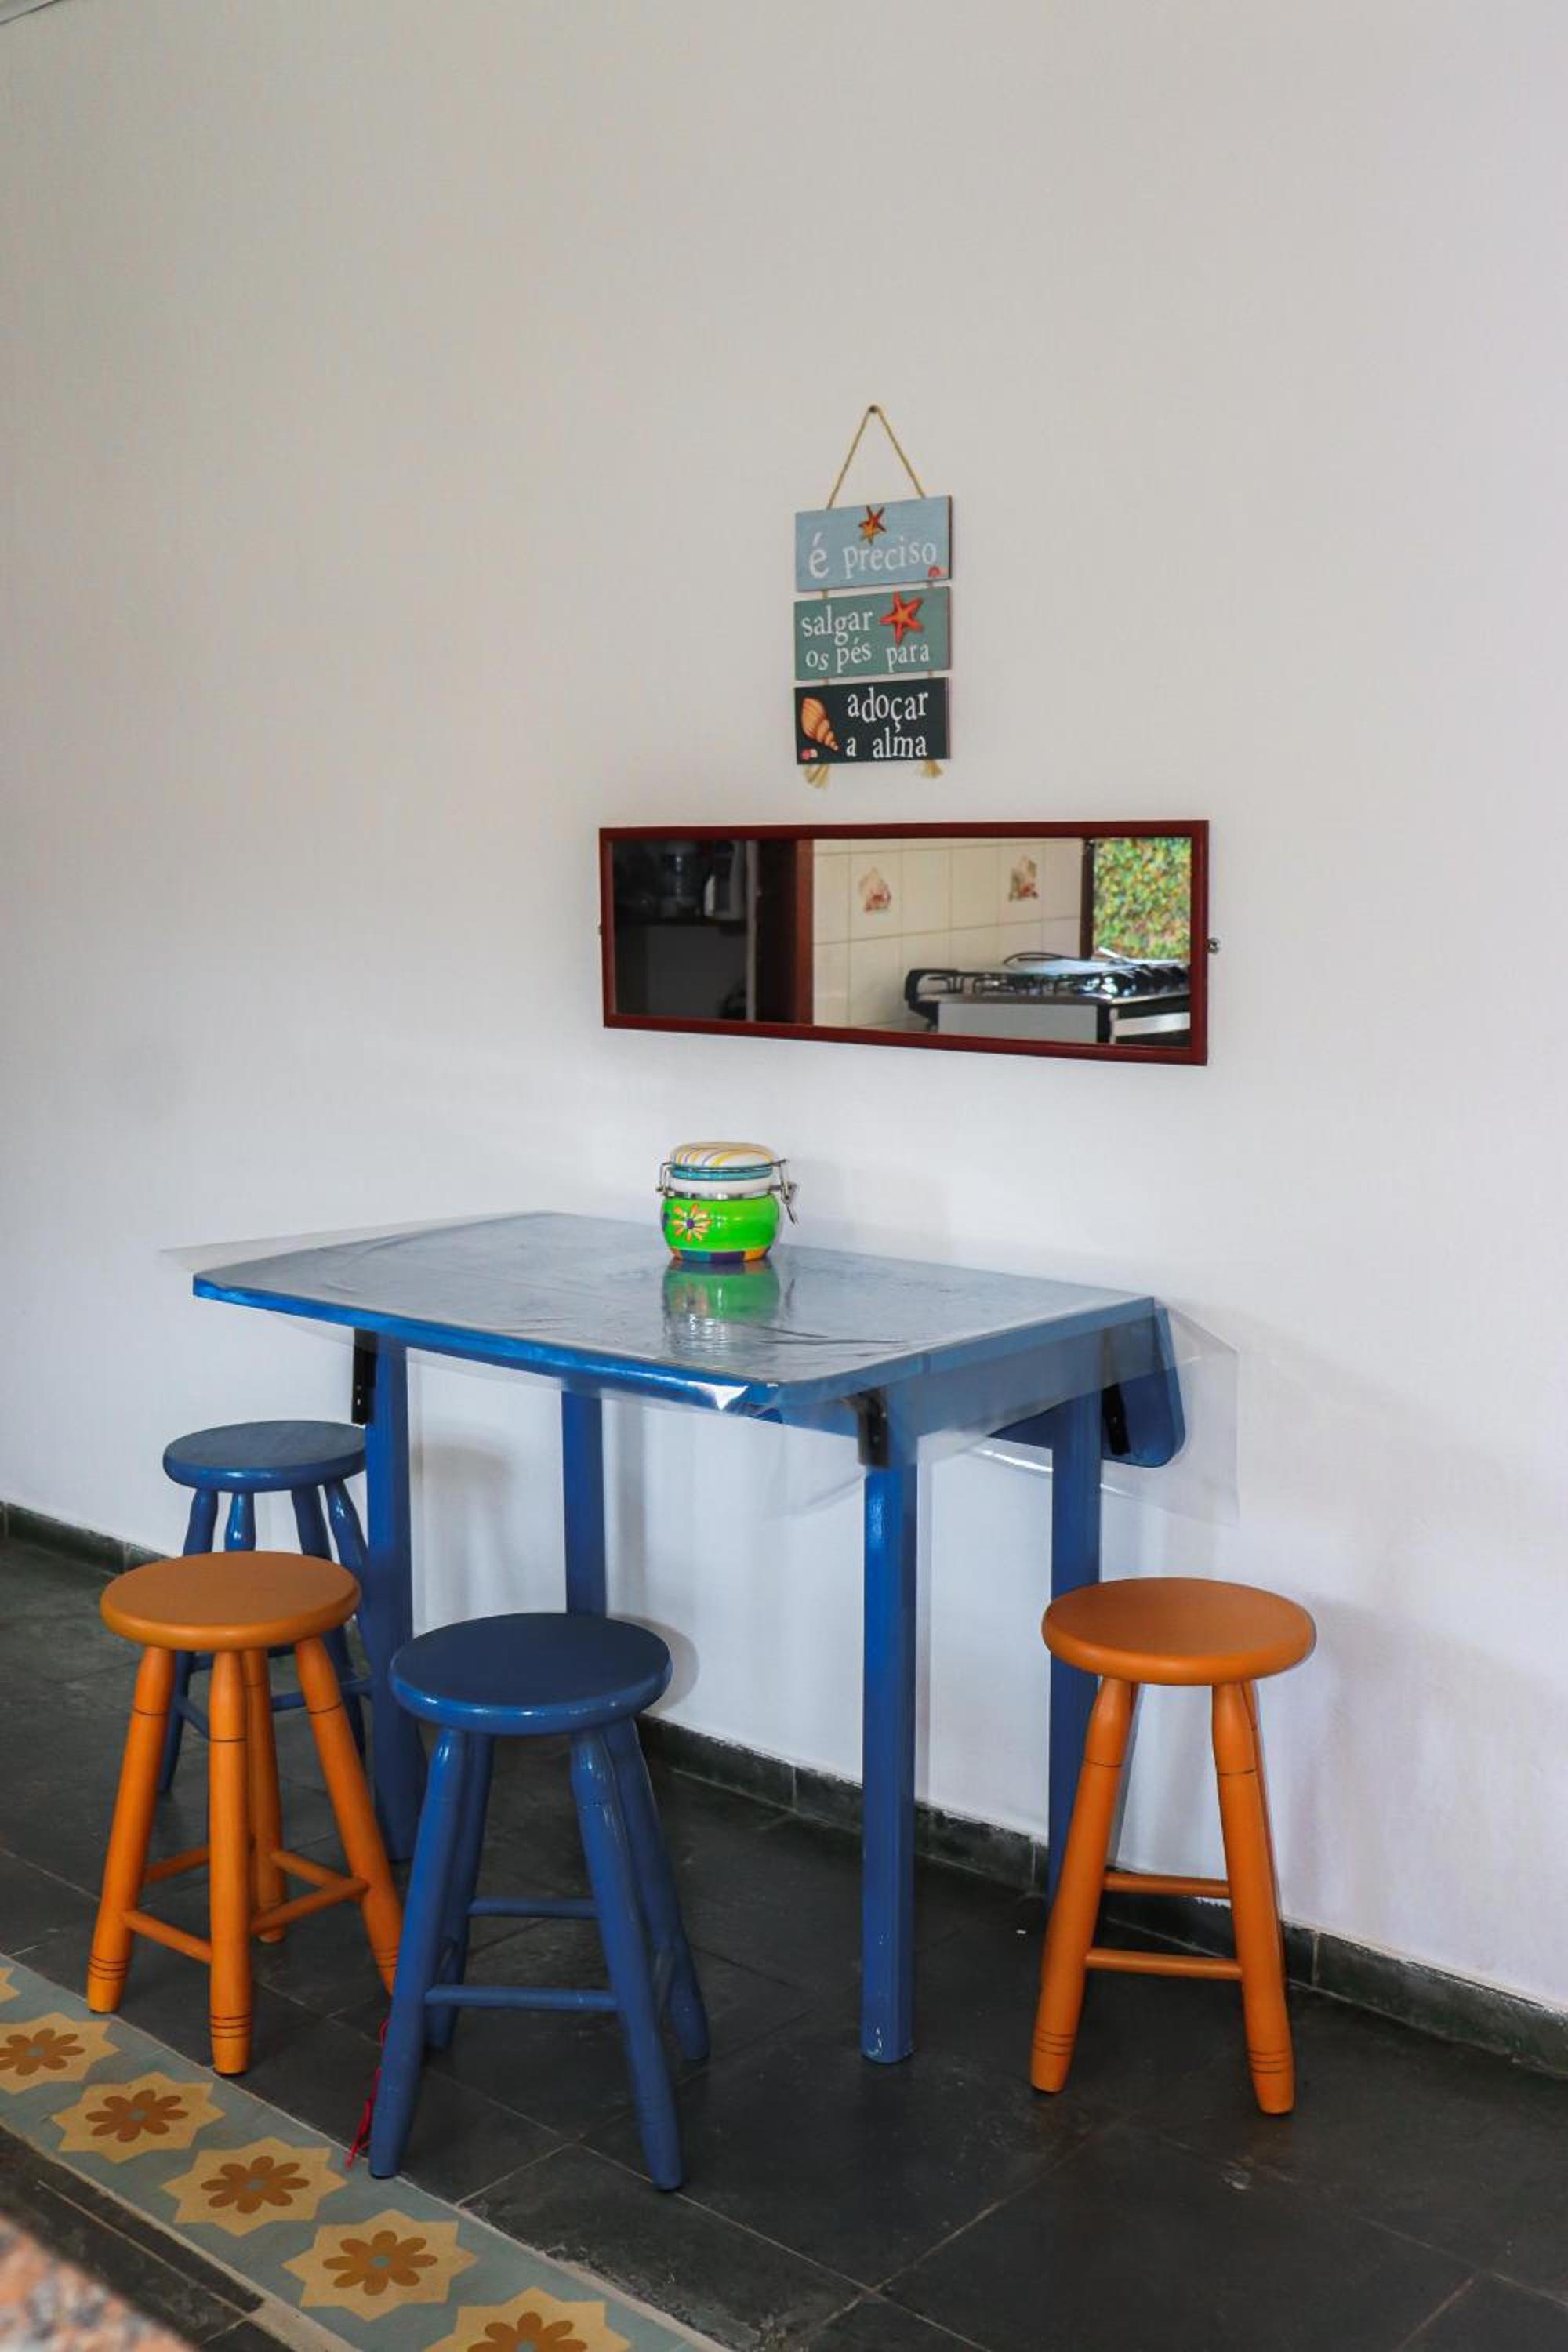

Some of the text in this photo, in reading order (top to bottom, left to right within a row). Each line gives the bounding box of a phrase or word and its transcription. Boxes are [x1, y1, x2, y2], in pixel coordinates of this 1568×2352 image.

[809, 532, 938, 579] é preciso
[801, 604, 873, 647] salgar
[806, 637, 930, 673] os pés para
[847, 686, 928, 732] adoçar
[846, 727, 928, 758] a alma
